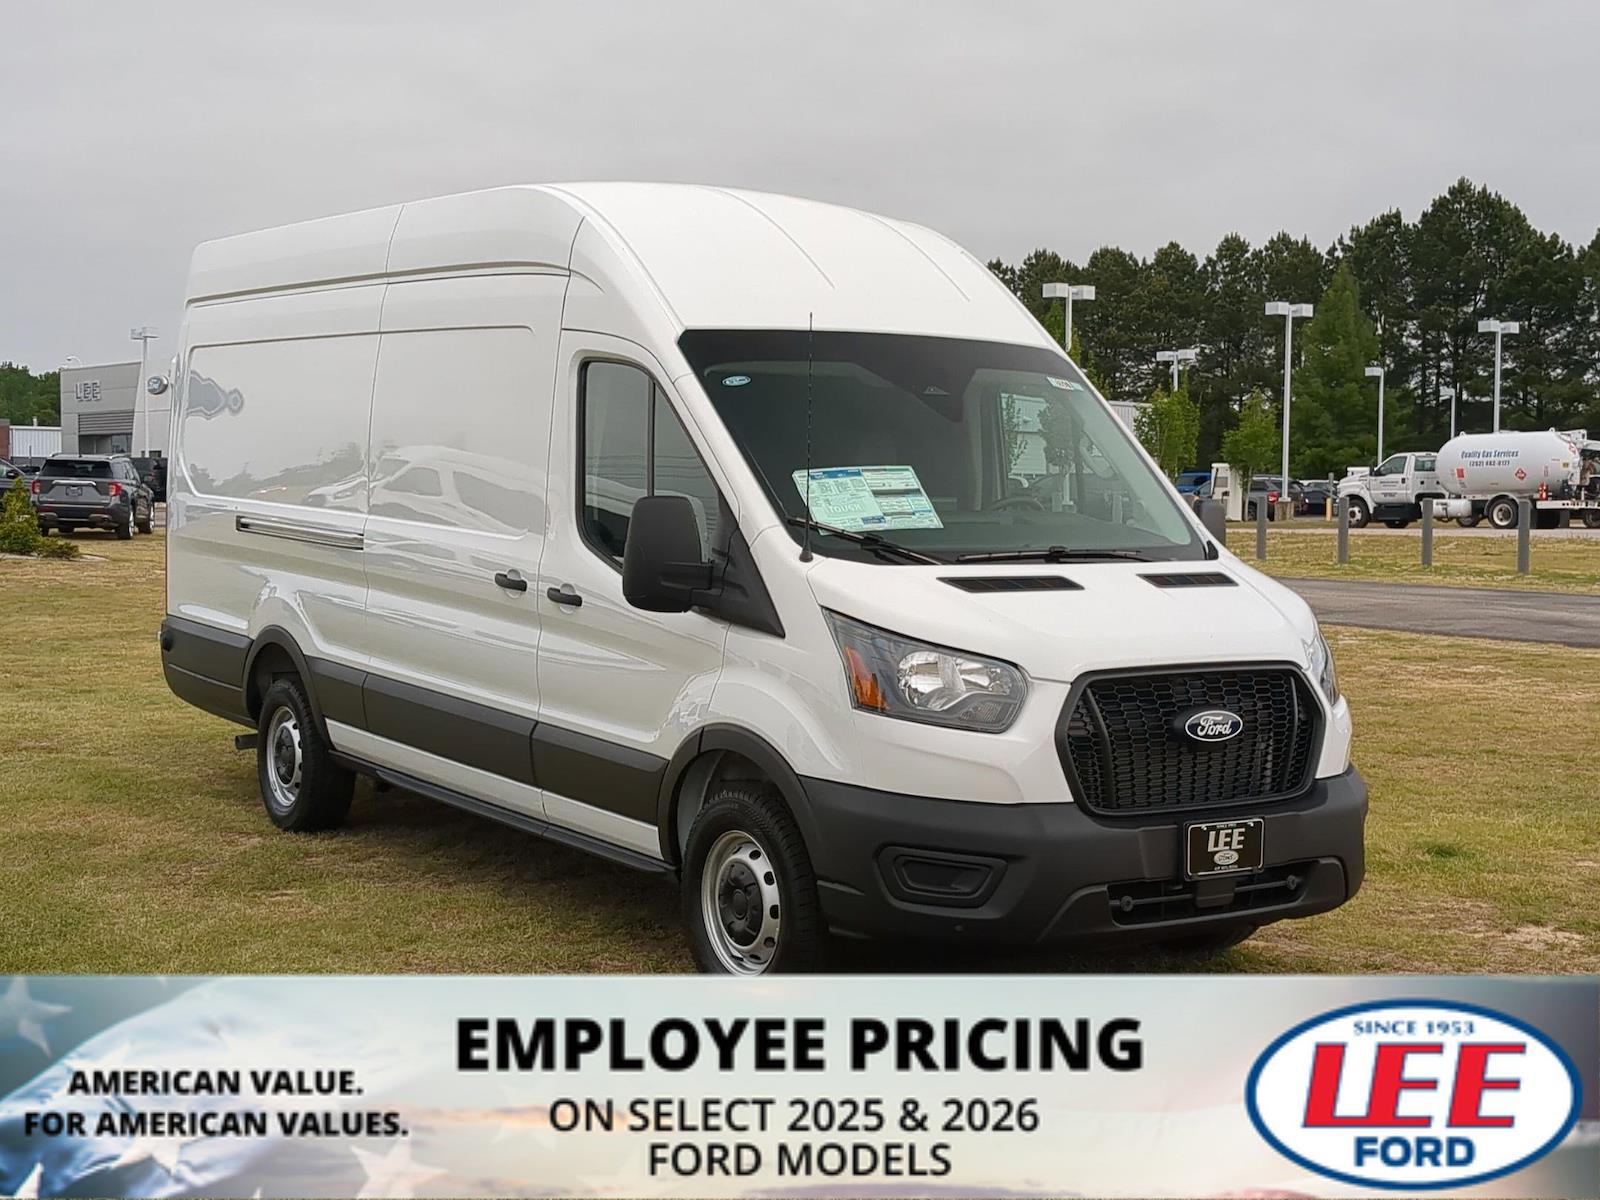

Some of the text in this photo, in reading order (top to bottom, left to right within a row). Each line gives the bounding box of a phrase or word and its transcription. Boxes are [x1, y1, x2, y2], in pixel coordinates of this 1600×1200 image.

[75, 382, 101, 402] LEE
[1197, 715, 1232, 736] Ford
[1208, 828, 1245, 852] LEE
